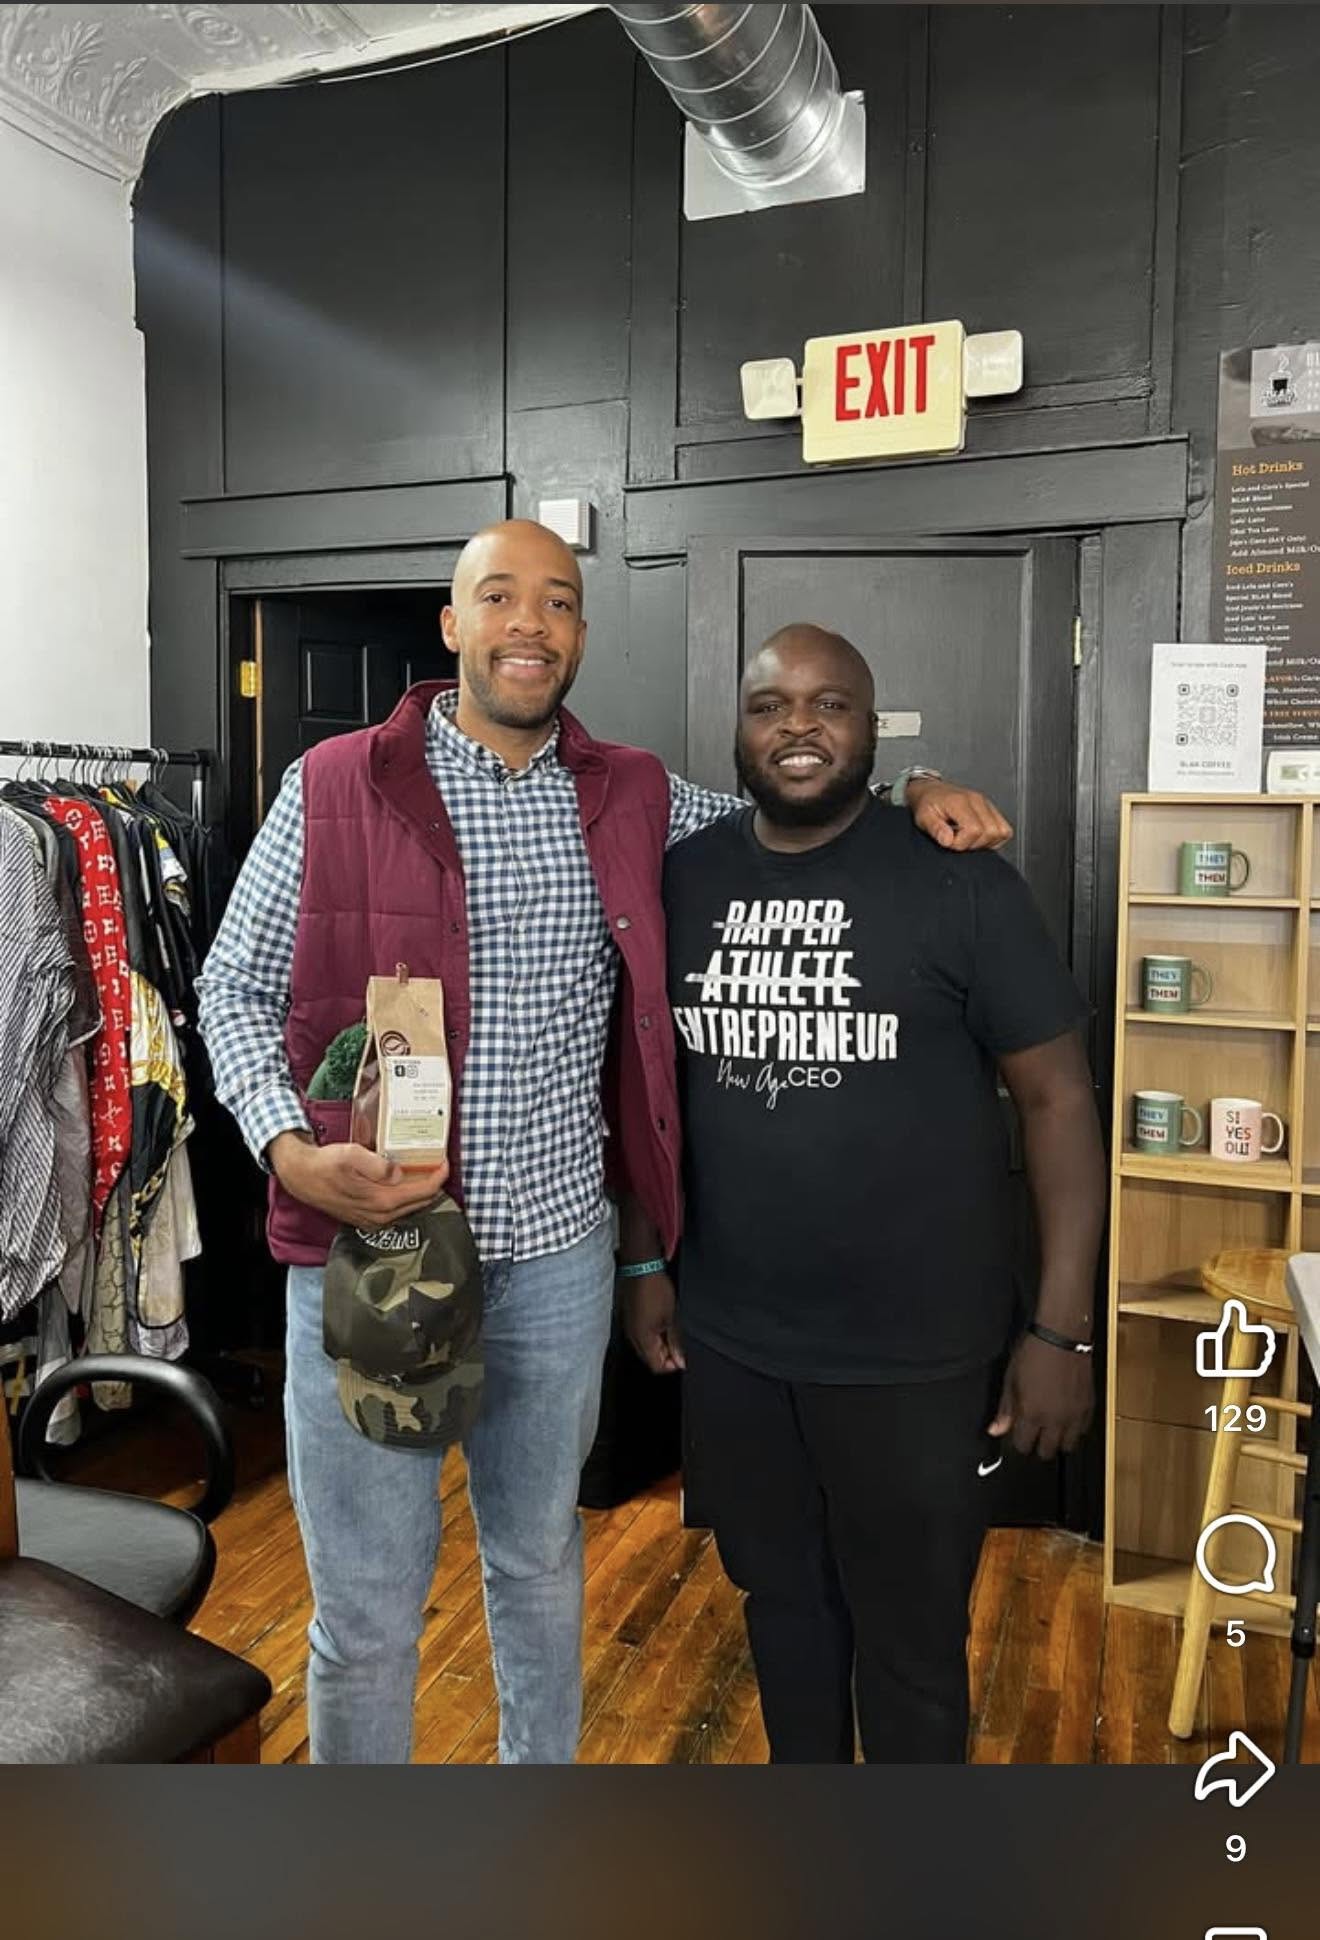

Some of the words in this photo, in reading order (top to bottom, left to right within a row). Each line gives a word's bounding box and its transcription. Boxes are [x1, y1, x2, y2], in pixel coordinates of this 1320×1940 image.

[835, 335, 935, 421] EXIT
[1232, 464, 1256, 476] Hot
[1259, 460, 1304, 474] Drinks
[1226, 563, 1254, 576] Iced
[1256, 560, 1301, 574] Drinks
[1198, 872, 1226, 883] THEM
[721, 899, 846, 946] RAPPER
[700, 950, 854, 1007] ATHLETE
[1150, 969, 1178, 980] THEY
[1149, 987, 1179, 999] THEM
[673, 1006, 900, 1063] ENTREPRENEUR
[787, 1065, 843, 1089] CEO
[1138, 1126, 1166, 1139] THEM
[1225, 1124, 1252, 1141] YES
